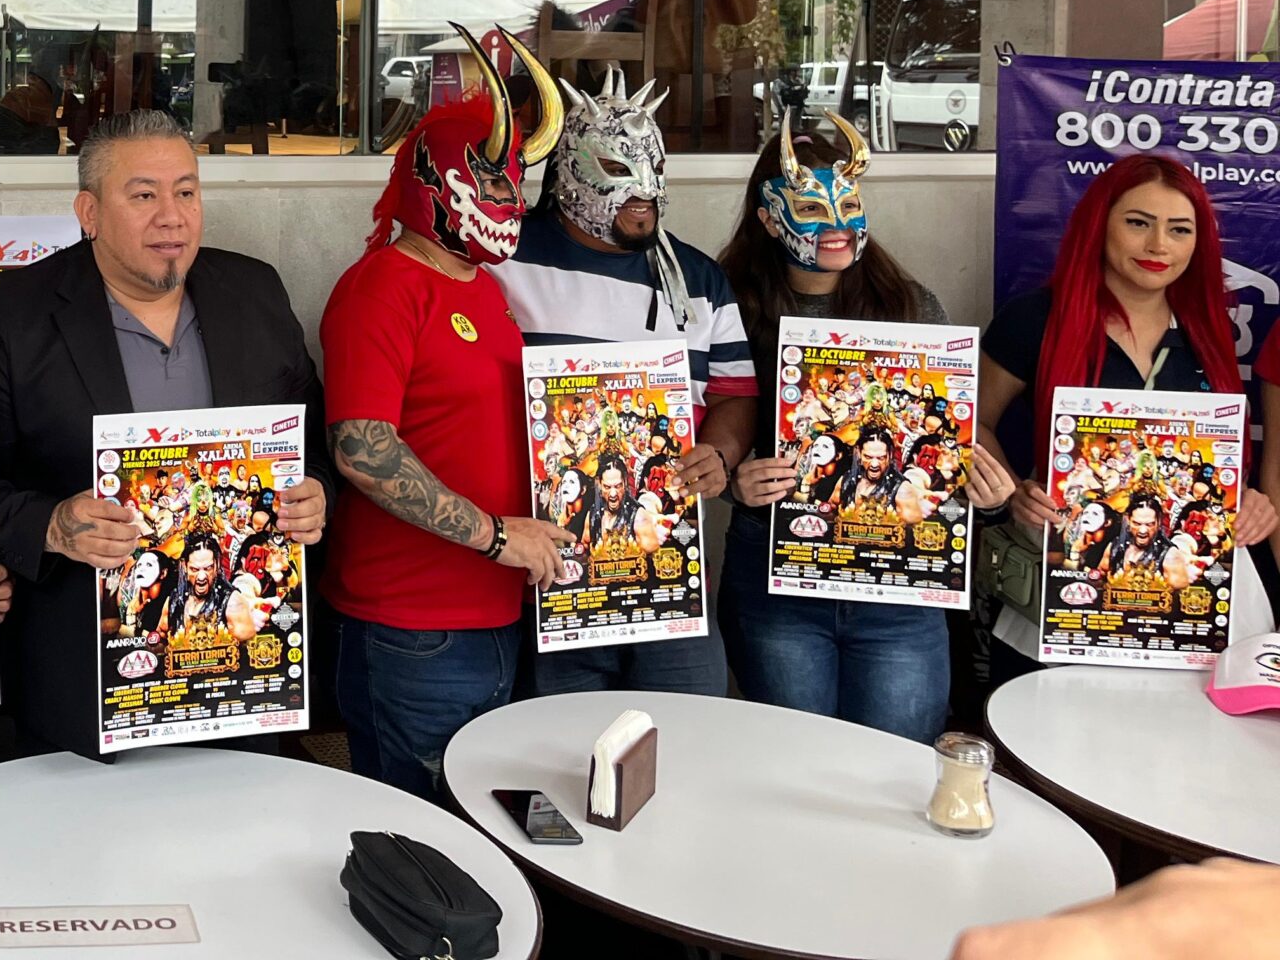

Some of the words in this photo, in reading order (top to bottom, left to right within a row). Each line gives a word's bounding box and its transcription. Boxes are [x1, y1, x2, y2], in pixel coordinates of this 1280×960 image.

[1055, 111, 1162, 150] 800
[1176, 115, 1279, 154] 330
[873, 338, 907, 348] Totalplay
[950, 339, 974, 350] CINETIX
[804, 347, 816, 357] 31
[821, 348, 865, 360] OCTUBRE
[602, 359, 630, 370] Totalplay
[874, 357, 921, 369] XALAPA
[547, 379, 557, 389] 31
[560, 376, 597, 388] OCTUBRE
[604, 378, 643, 391] XALAPA
[1145, 406, 1178, 416] Totalplay
[195, 427, 230, 439] Totalplay
[273, 418, 296, 431] CINETIX
[1077, 416, 1089, 426] 31
[1093, 417, 1137, 428] OCTUBRE
[1145, 425, 1190, 436] XALAPA
[223, 442, 242, 450] ARENA
[262, 444, 298, 453] EXPRESS
[122, 450, 136, 461] 31
[140, 446, 188, 460] OCTUBRE
[197, 448, 245, 463] XALAPA
[123, 461, 145, 469] VIERNES
[780, 502, 818, 511] AVANRADIO
[793, 515, 823, 531] AAA
[842, 524, 892, 534] TERRITORIO
[892, 525, 903, 543] 3
[594, 559, 636, 572] TERRITORIO
[635, 556, 645, 576] 3
[1159, 591, 1170, 608] 3
[106, 636, 146, 648] AVANRADIO
[121, 650, 152, 671] AAA
[173, 648, 225, 663] TERRITORIO
[225, 645, 236, 666] 3
[0, 918, 177, 933] RESERVADO
